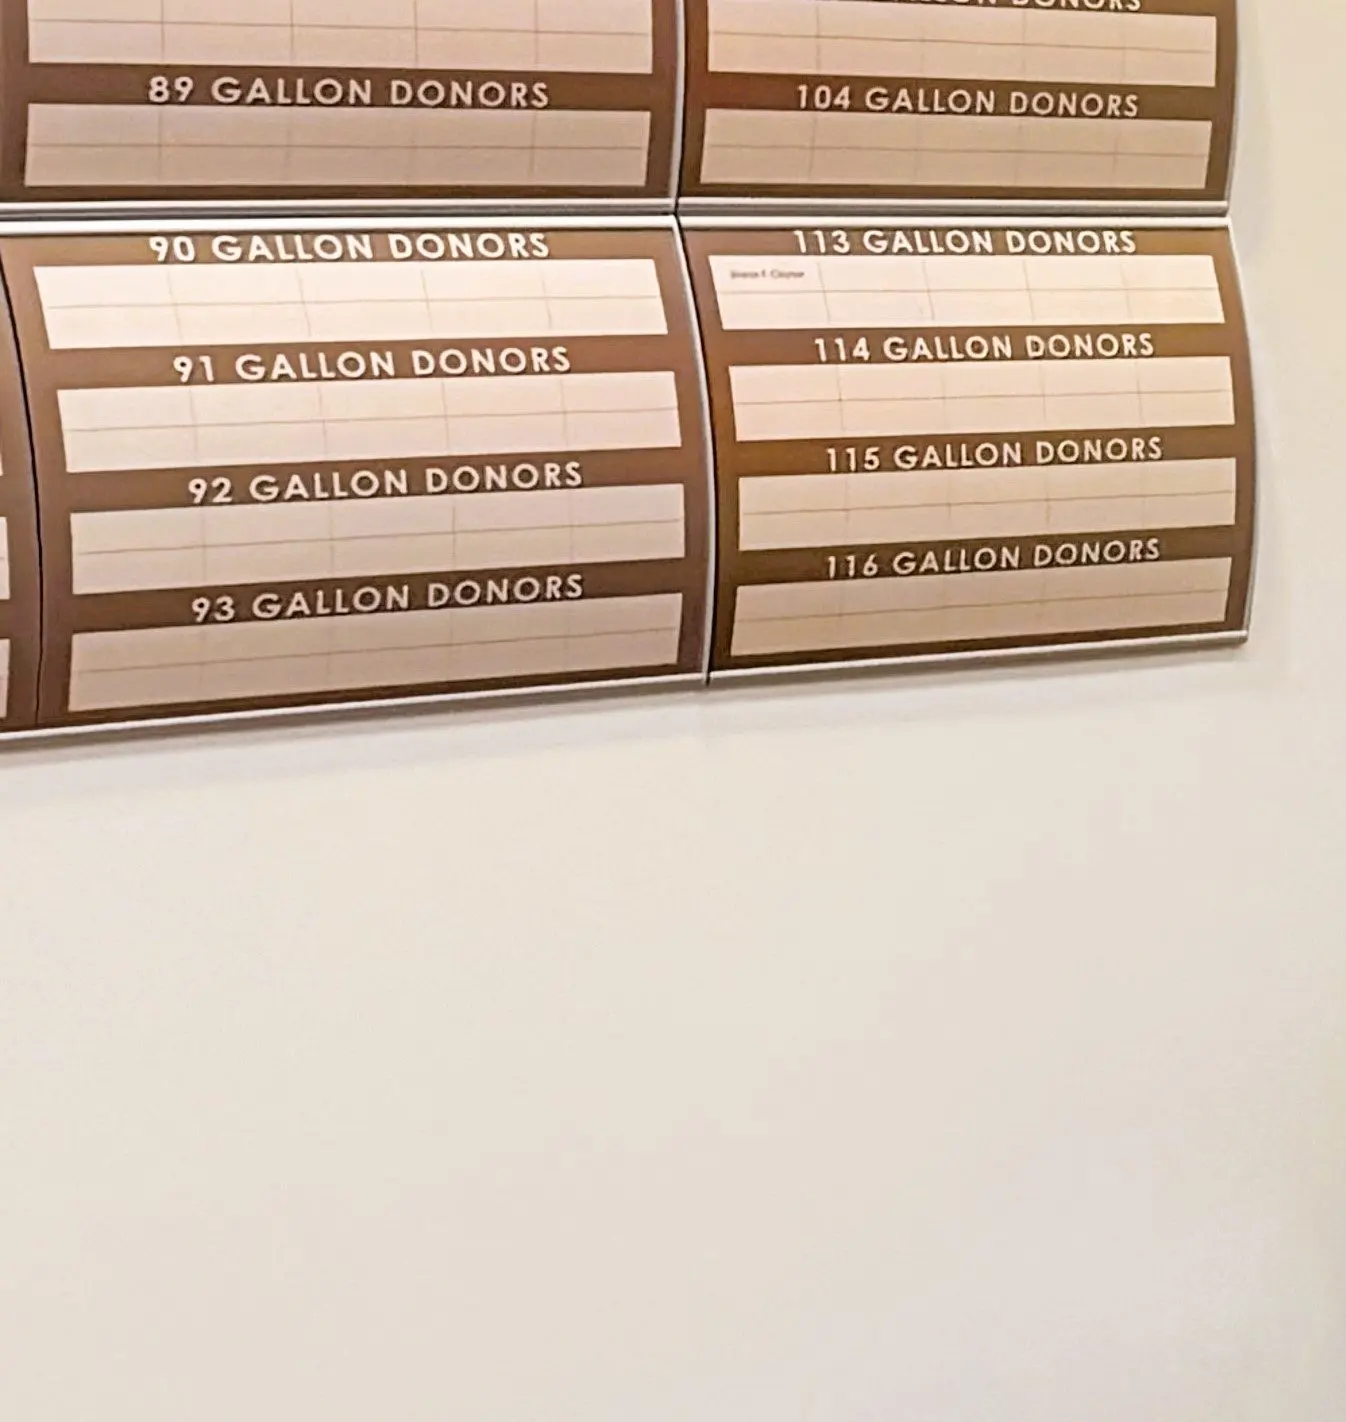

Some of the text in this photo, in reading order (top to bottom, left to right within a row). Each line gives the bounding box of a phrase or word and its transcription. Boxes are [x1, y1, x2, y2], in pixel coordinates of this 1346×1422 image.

[149, 76, 549, 108] 89 GALLON DONORS
[797, 85, 1138, 117] 104 GALLON DONORS
[148, 233, 549, 262] 90 GALLON DONORS
[794, 229, 1136, 254] 113 GALLON DONORS
[815, 333, 1154, 361] 114 GALLON DONORS
[172, 347, 570, 382] 91 GALLON DONORS
[827, 437, 1162, 471] 115 GALLON DONORS
[188, 461, 582, 504] 92 GALLON DONORS
[827, 538, 1160, 579] 116 GALLON DONORS
[191, 574, 583, 622] 93 GALLON DONORS
